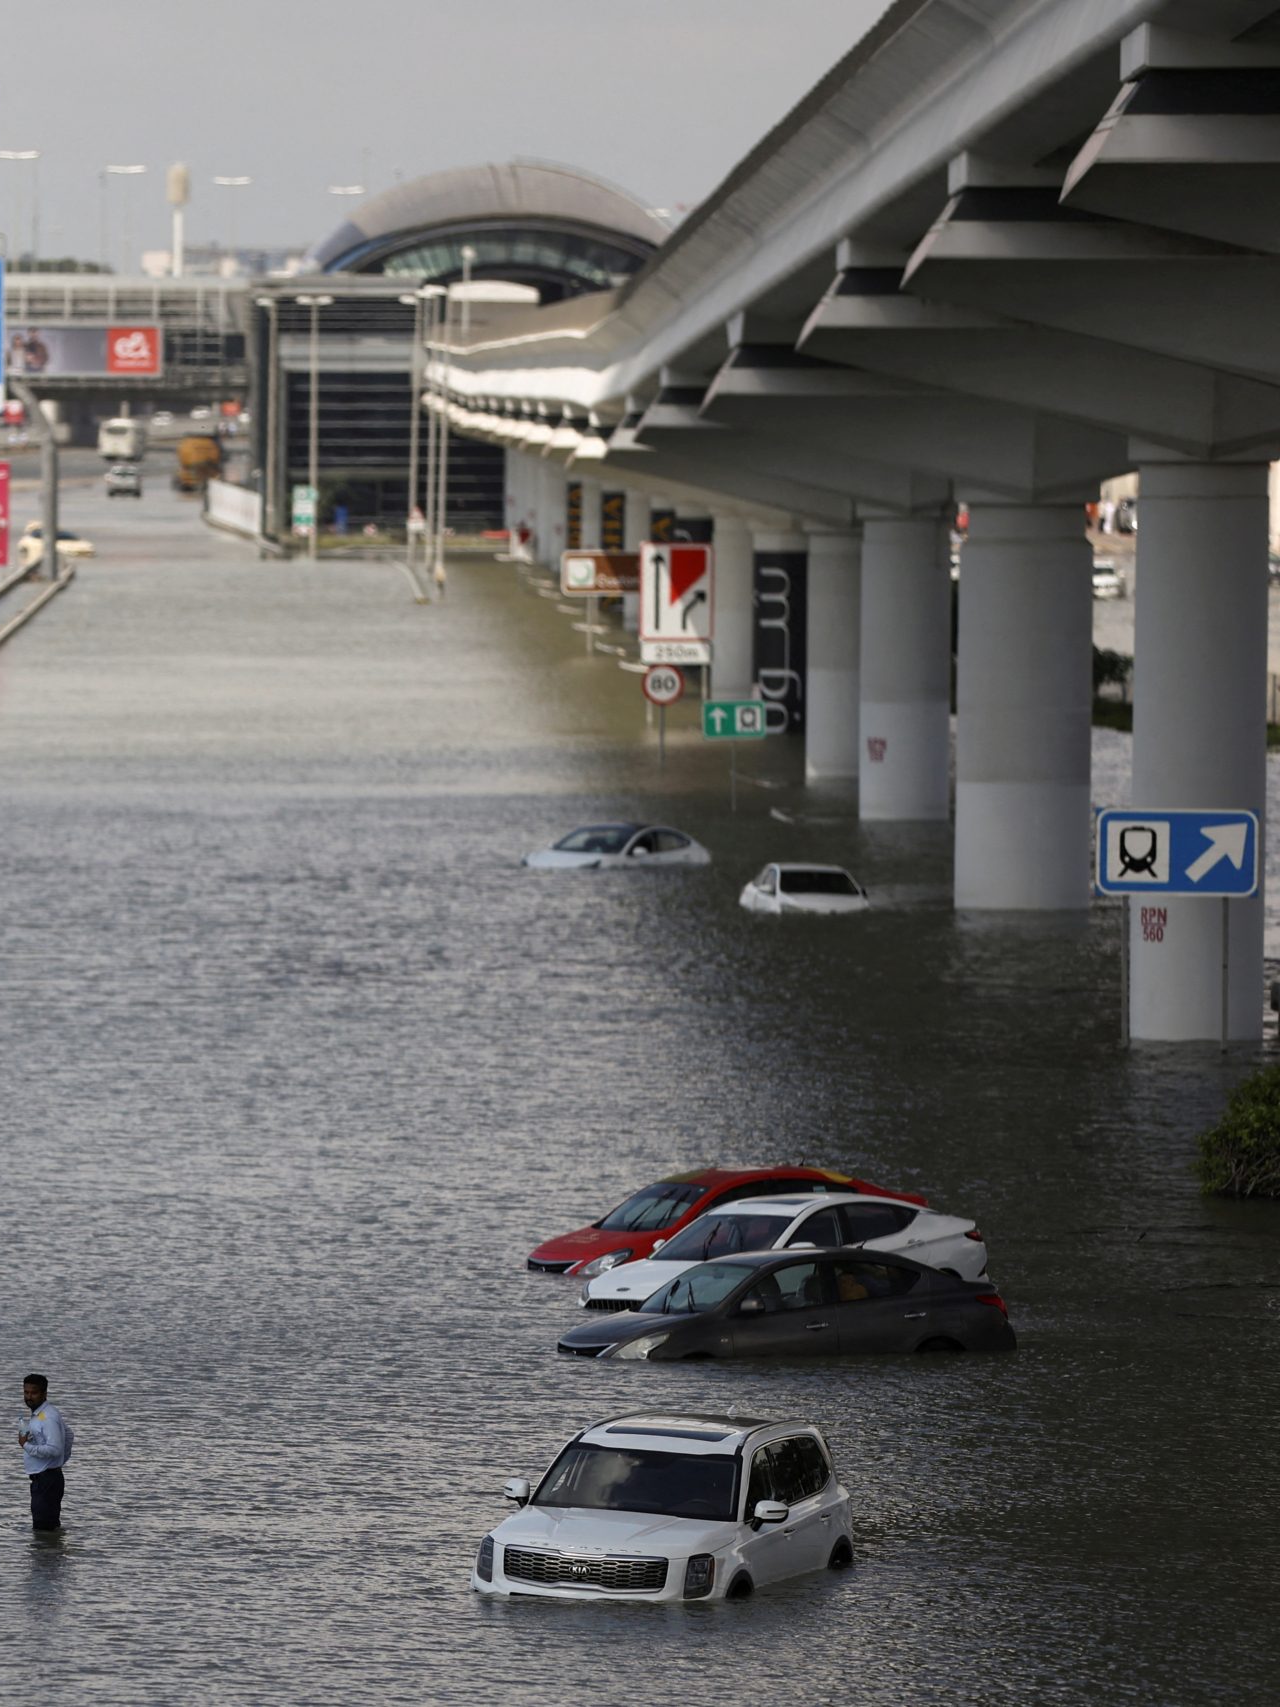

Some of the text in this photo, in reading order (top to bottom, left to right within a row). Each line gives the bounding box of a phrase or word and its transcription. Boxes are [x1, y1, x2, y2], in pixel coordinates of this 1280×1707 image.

[651, 674, 677, 694] 80
[1140, 907, 1168, 926] RPN
[571, 1566, 588, 1574] KIA
